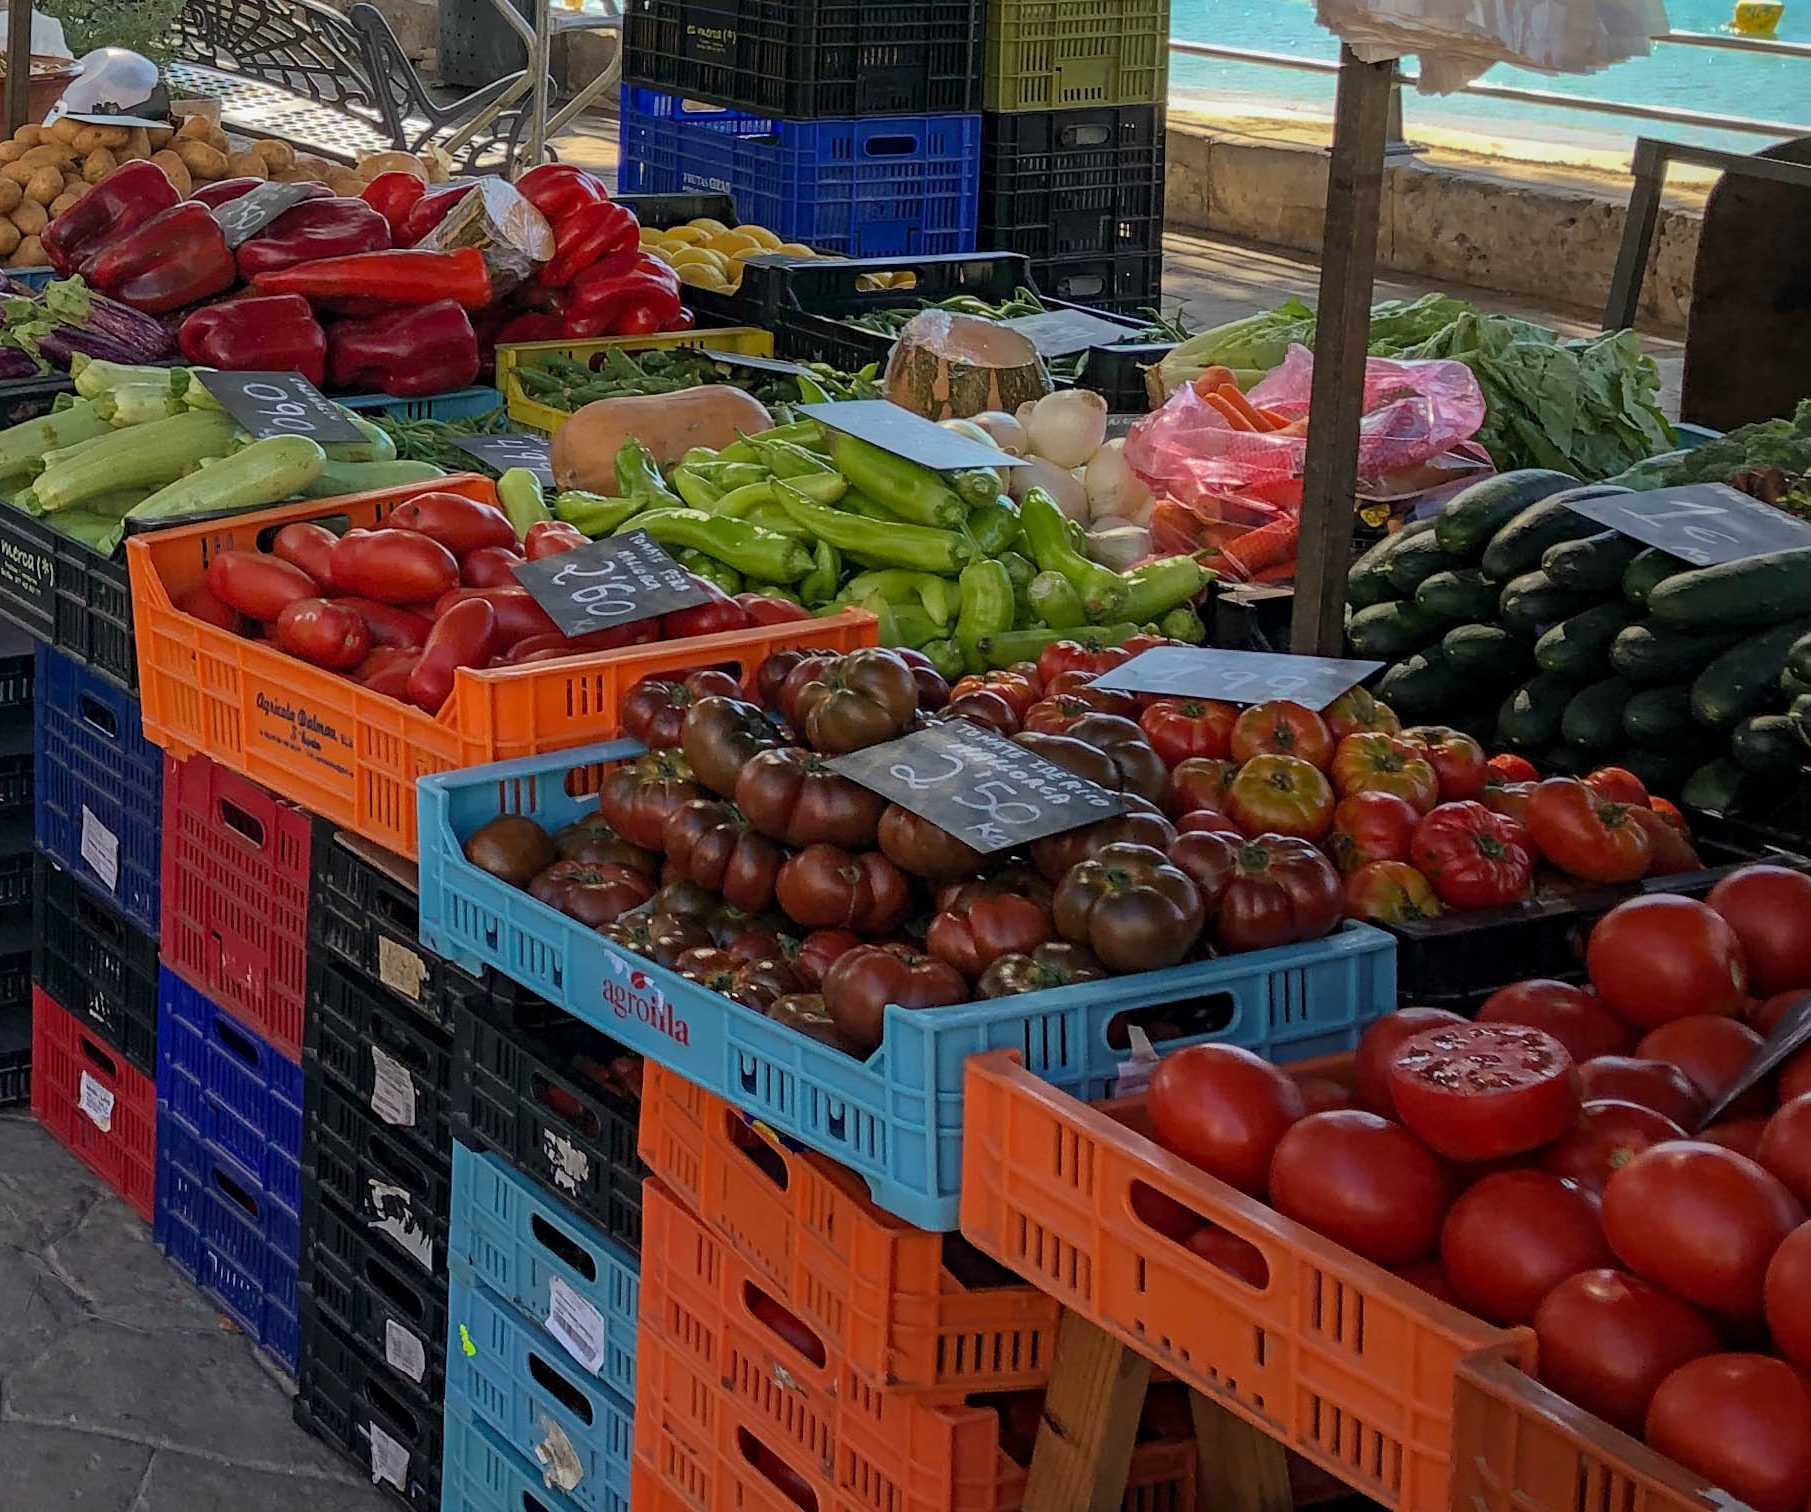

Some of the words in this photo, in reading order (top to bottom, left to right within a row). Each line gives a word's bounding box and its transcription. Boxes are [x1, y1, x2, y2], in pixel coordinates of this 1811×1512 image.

[0, 538, 36, 573] merca
[551, 559, 638, 617] 2'60
[954, 722, 1029, 760] TOMATE
[889, 753, 1041, 825] 2'50
